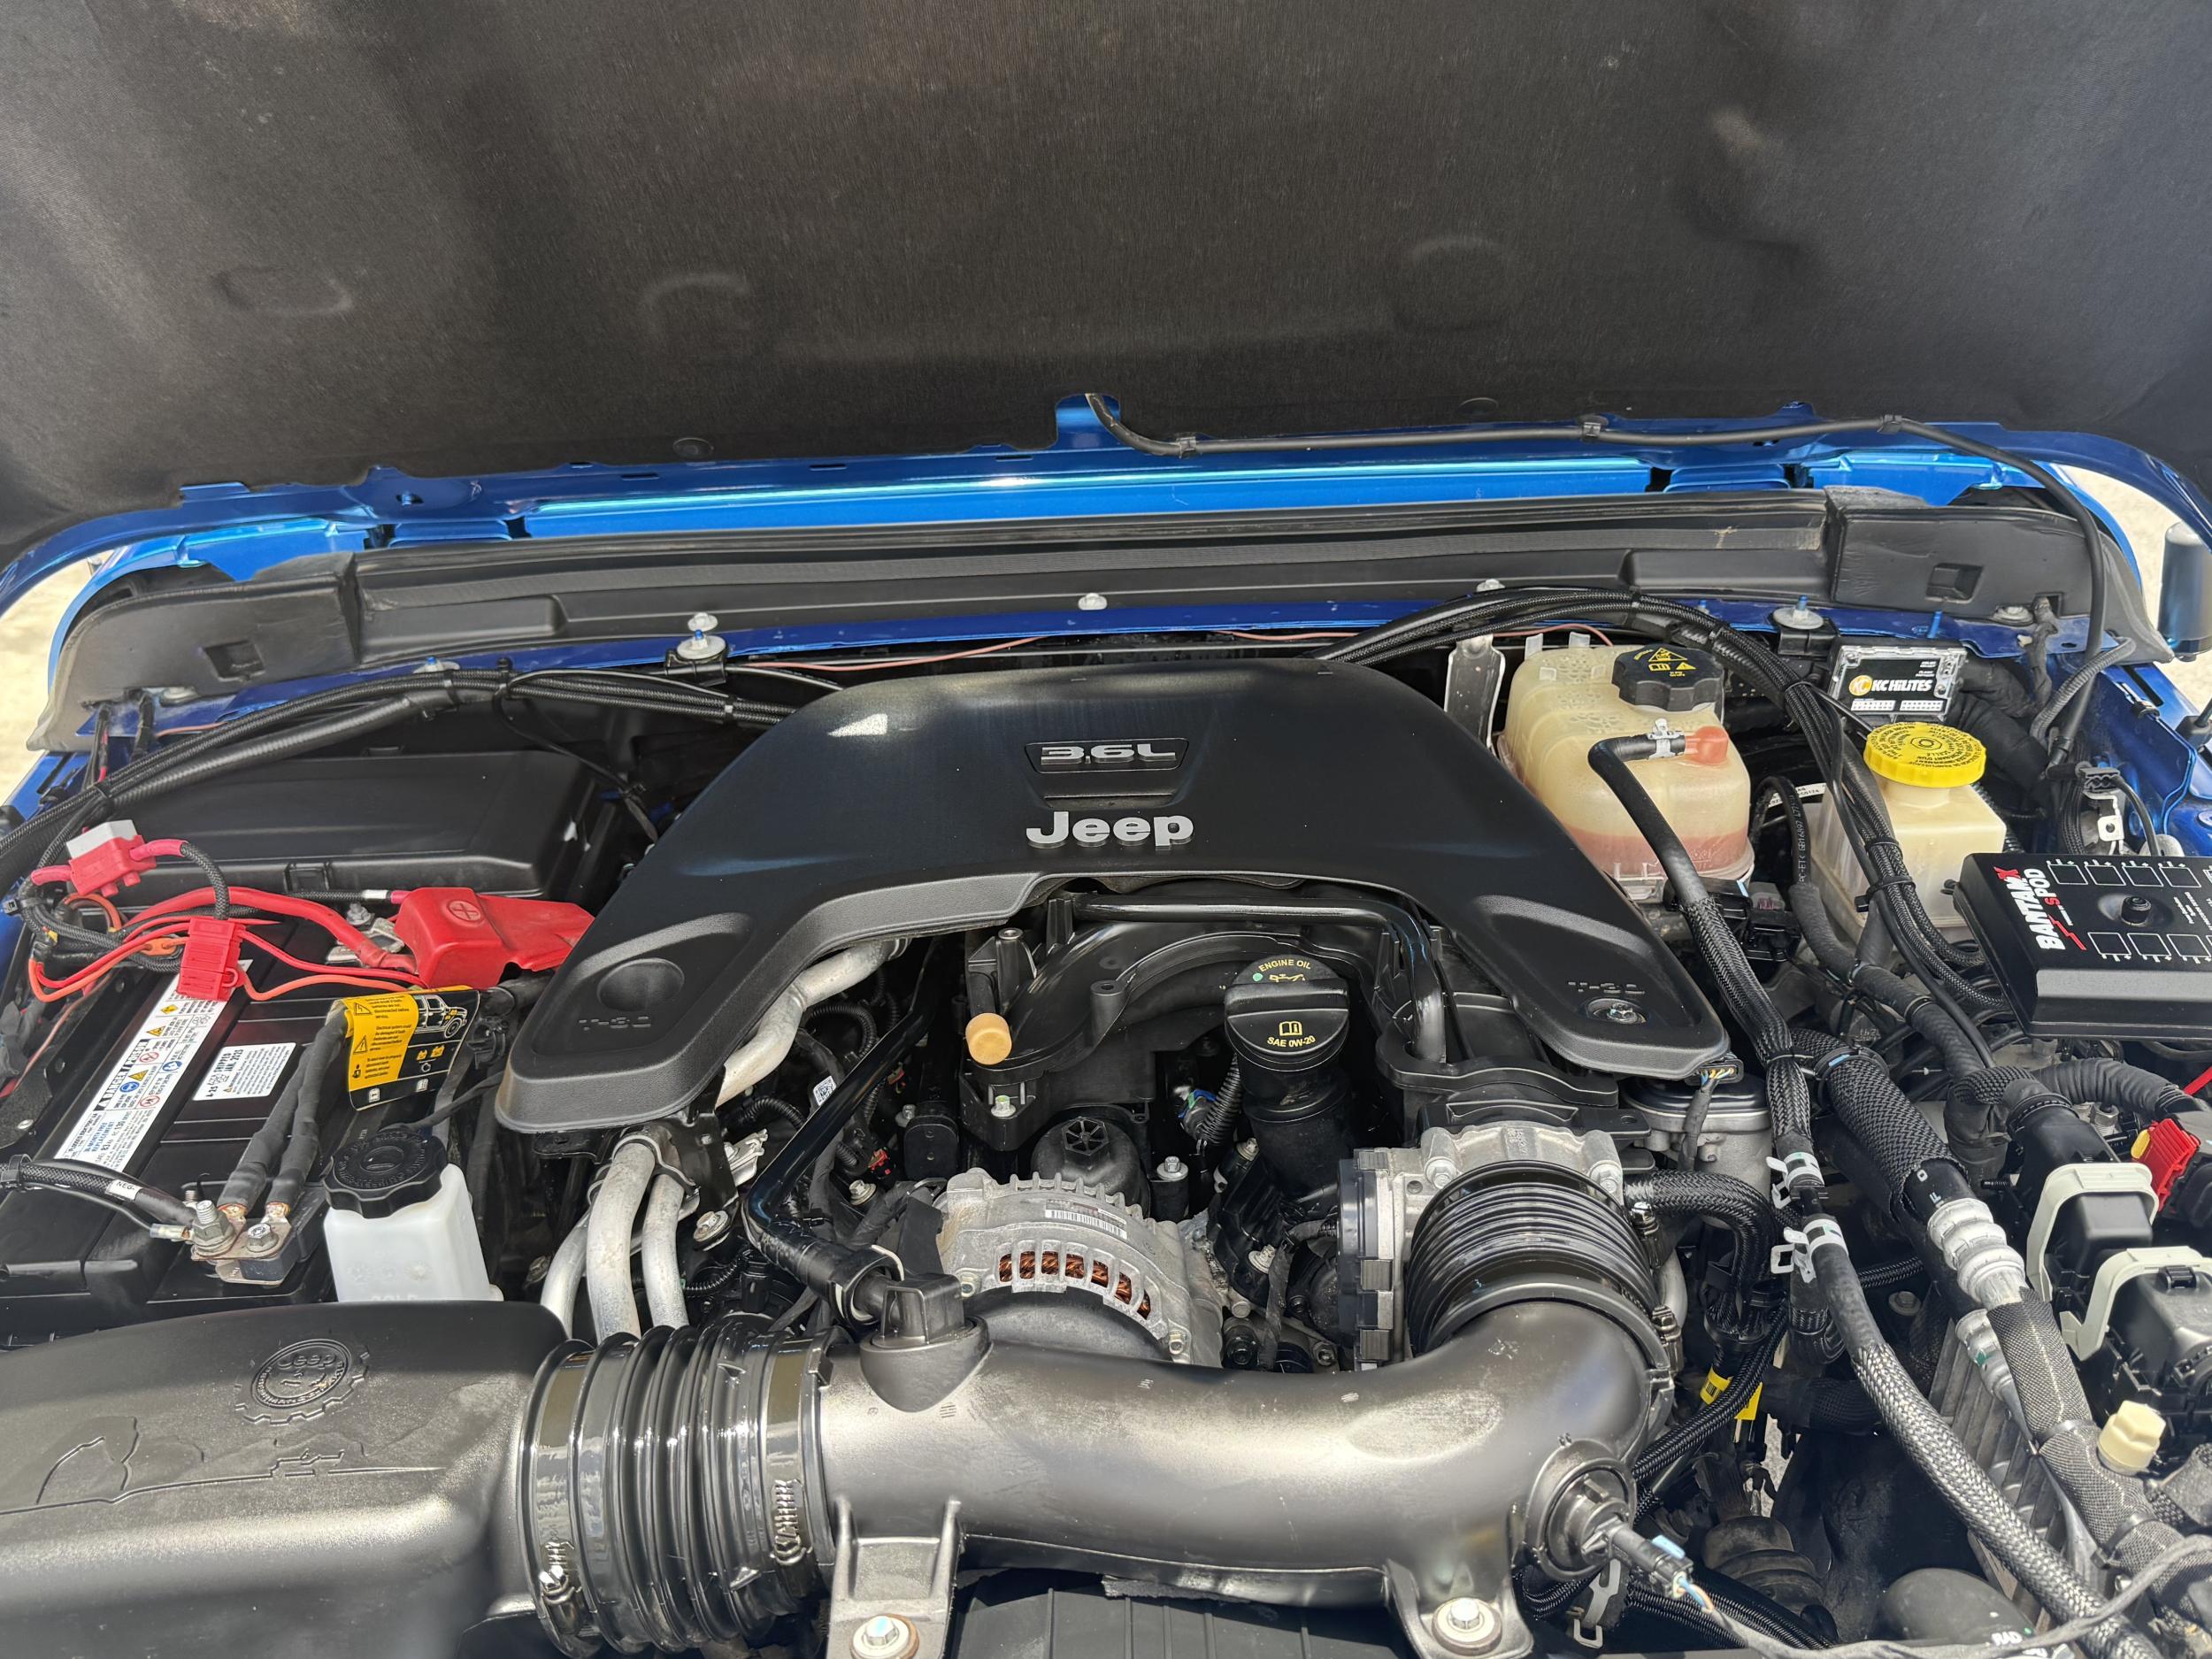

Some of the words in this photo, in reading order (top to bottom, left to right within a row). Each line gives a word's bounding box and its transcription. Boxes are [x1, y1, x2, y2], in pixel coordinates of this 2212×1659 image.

[1041, 743, 1176, 764] 3.6L
[1026, 811, 1194, 850] Jeep
[1258, 959, 1294, 972] ENGINE
[1296, 959, 1312, 970] OIL
[1267, 1037, 1286, 1048] SAE
[1288, 1035, 1317, 1048] 0W-20
